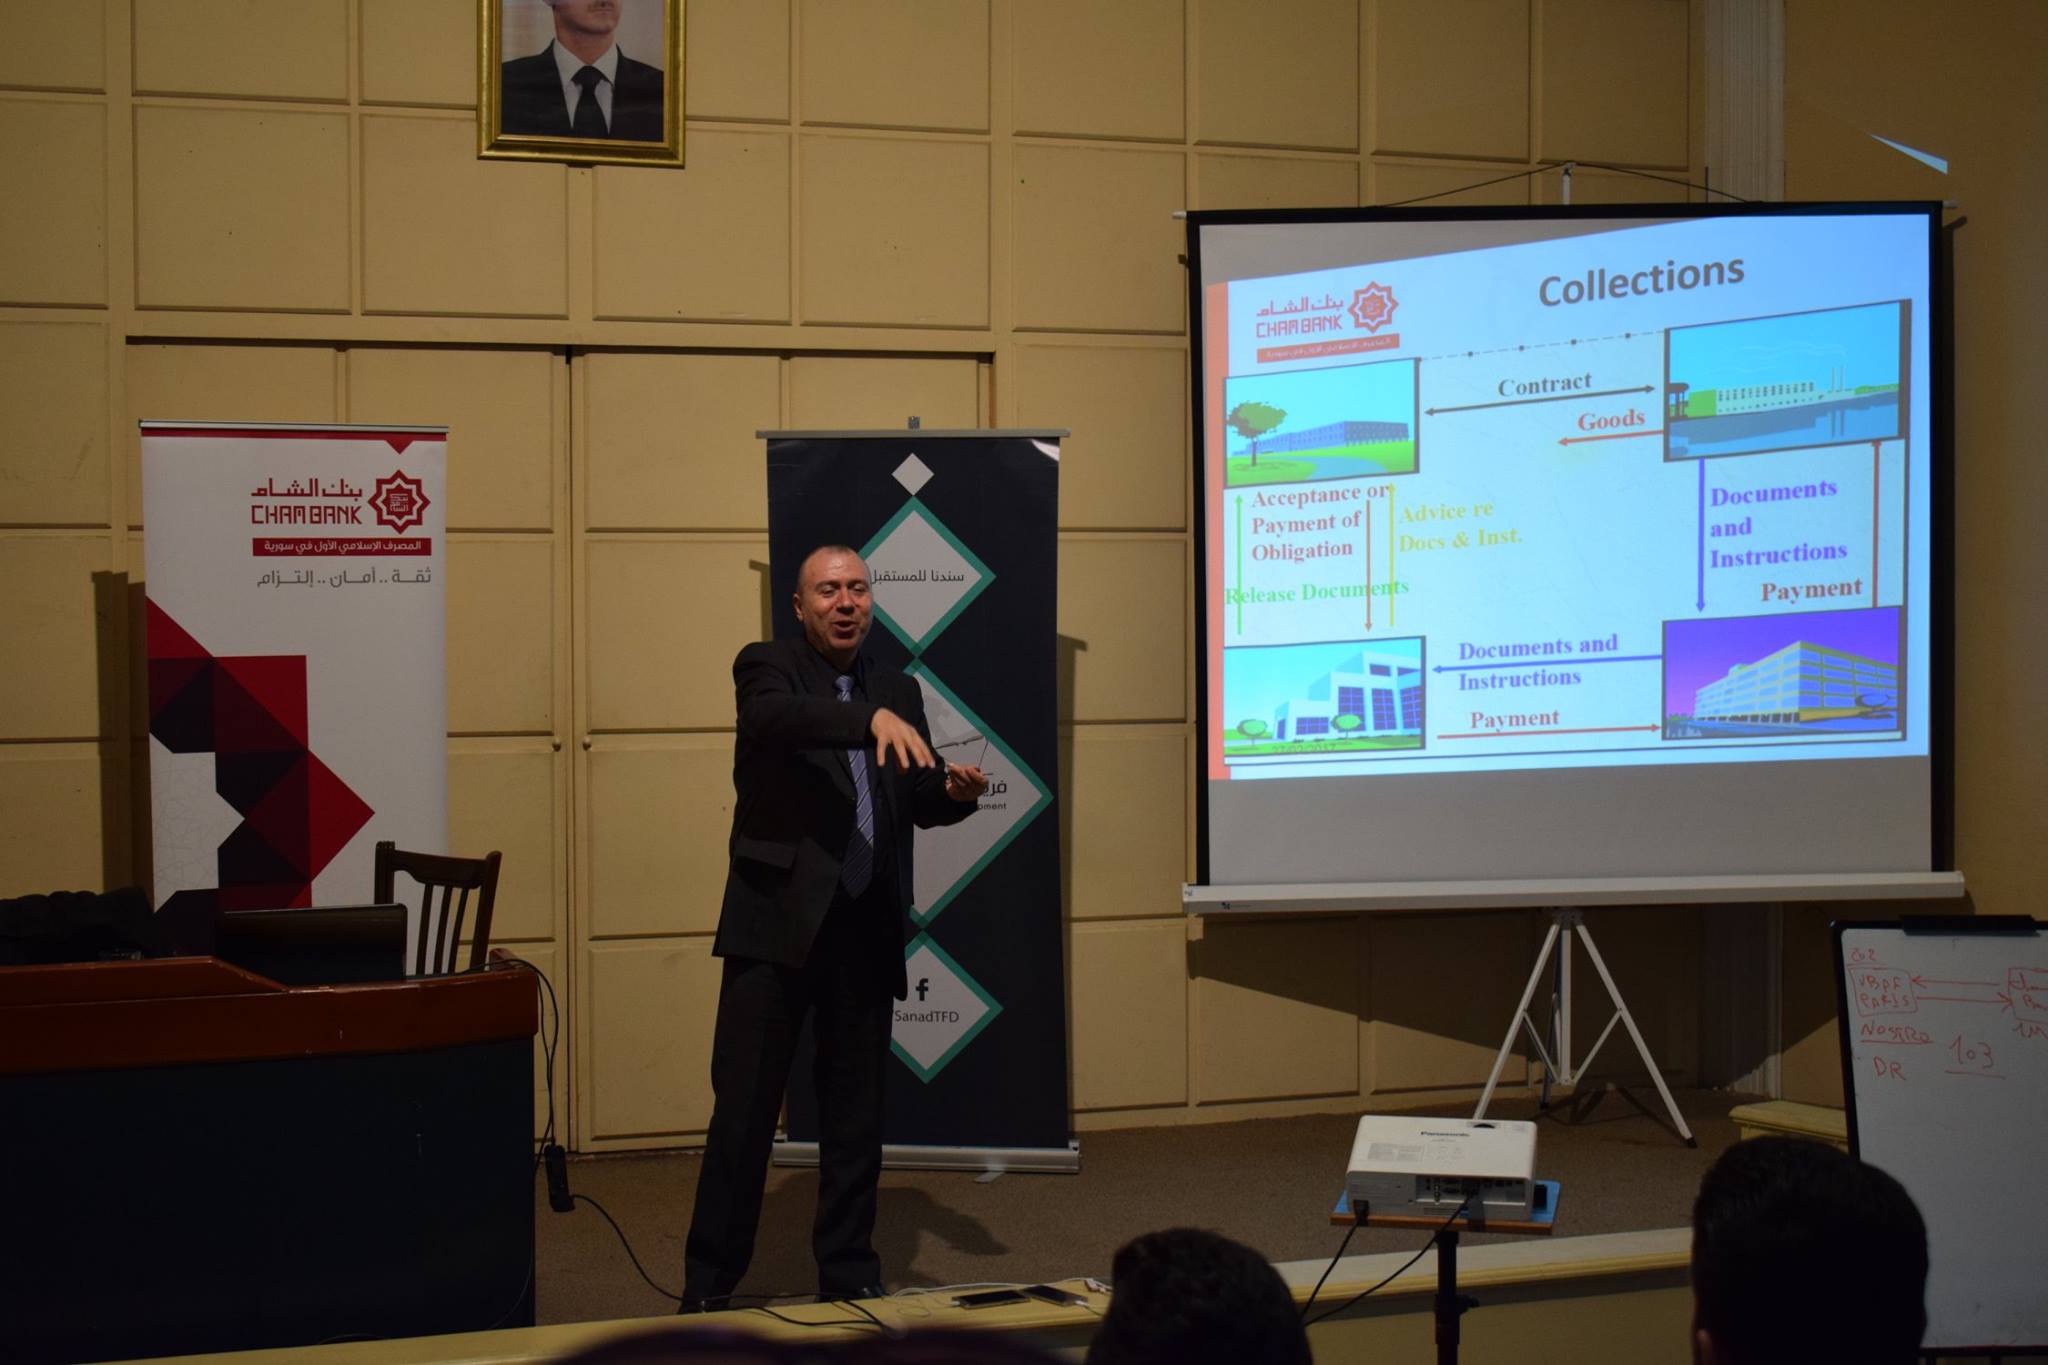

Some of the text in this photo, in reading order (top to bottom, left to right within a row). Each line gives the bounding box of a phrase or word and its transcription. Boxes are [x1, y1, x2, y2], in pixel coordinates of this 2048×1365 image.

[1539, 258, 1744, 307] Collections
[1256, 314, 1343, 338] CHAM BANK
[1498, 373, 1592, 397] Contract
[1578, 408, 1645, 431] Goods
[251, 477, 318, 497] الشام
[322, 478, 362, 502] بنك
[1252, 485, 1390, 510] Acceptance or
[1711, 480, 1838, 507] Documents
[251, 505, 362, 525] CHAM BANK
[1252, 510, 1362, 538] Payment of
[1399, 502, 1494, 522] Advice re
[1711, 516, 1752, 537] and
[264, 541, 294, 553] سورية
[295, 541, 313, 555] في
[383, 540, 422, 552] المصرف
[1399, 527, 1523, 552] Docs & Inst.
[1252, 540, 1353, 564] Obligation
[1711, 542, 1848, 569] Instructions
[391, 566, 432, 584] ثقة
[931, 568, 965, 582] سندنا
[1224, 581, 1410, 605] Release Documents
[1761, 577, 1863, 605] Payment
[1459, 633, 1619, 660] Documents and
[1459, 669, 1582, 691] Instructions
[1471, 710, 1560, 733] Payment
[1873, 1055, 1907, 1081] DR
